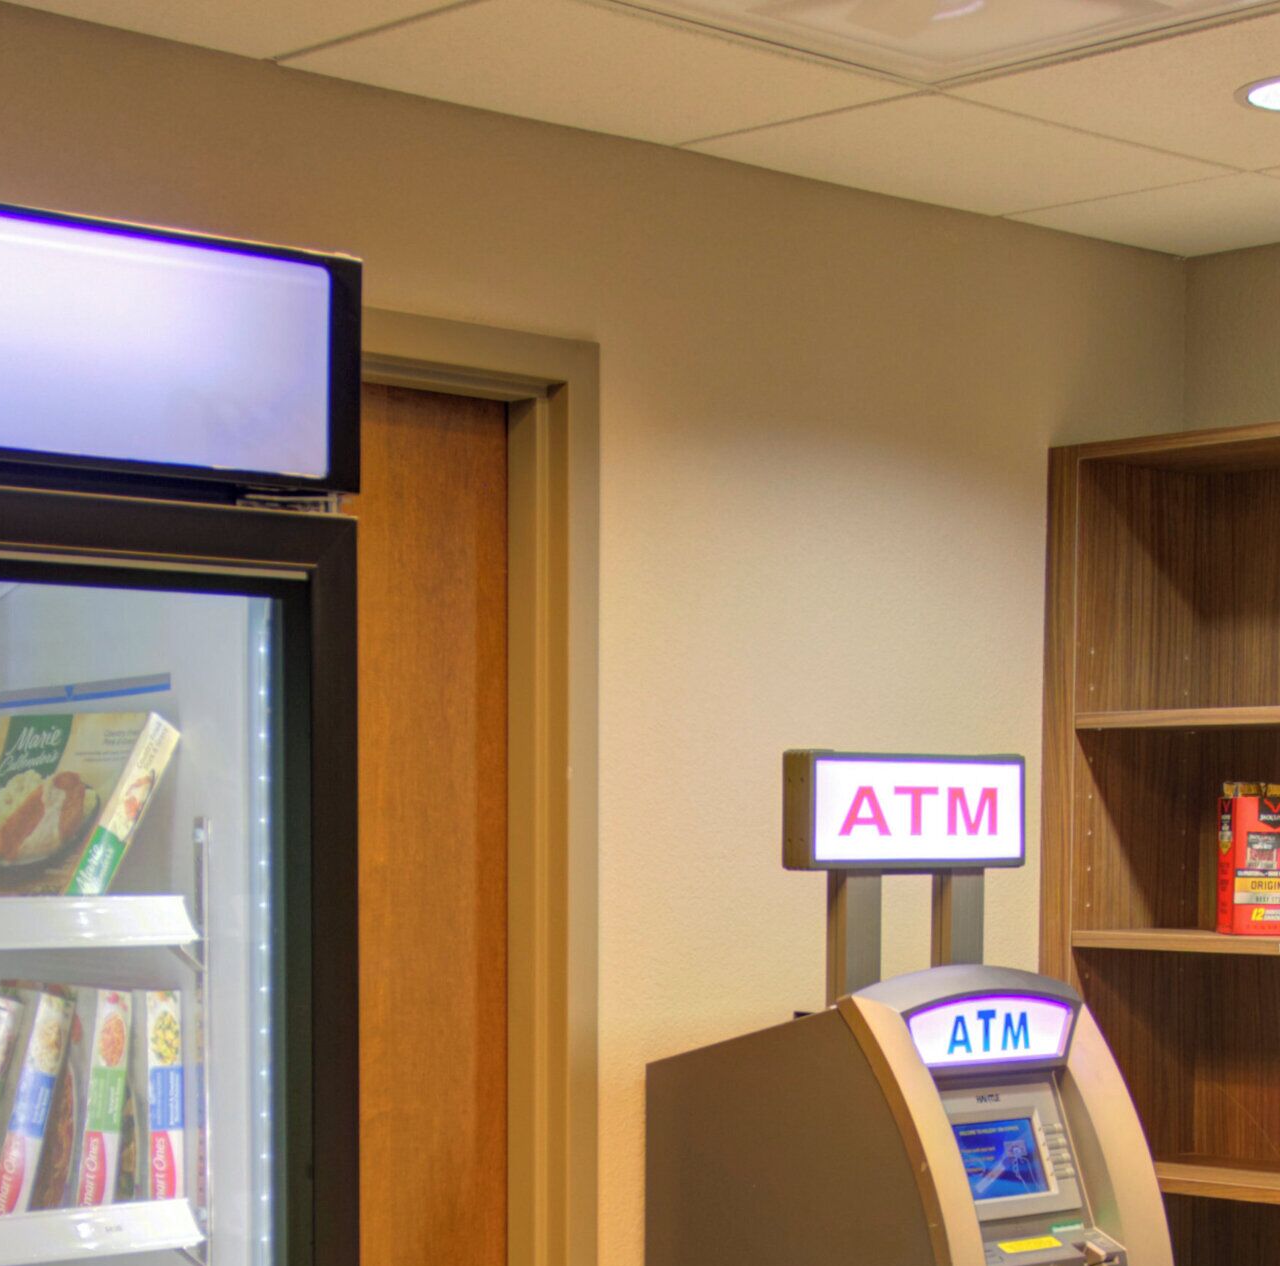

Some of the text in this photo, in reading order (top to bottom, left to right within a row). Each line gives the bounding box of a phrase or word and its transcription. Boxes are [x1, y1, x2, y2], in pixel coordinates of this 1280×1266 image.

[6, 726, 63, 757] Marie
[838, 786, 999, 836] ATM
[1251, 907, 1265, 921] 12
[947, 1009, 1030, 1055] ATM
[84, 1136, 100, 1172] Ones
[153, 1136, 166, 1172] Ones
